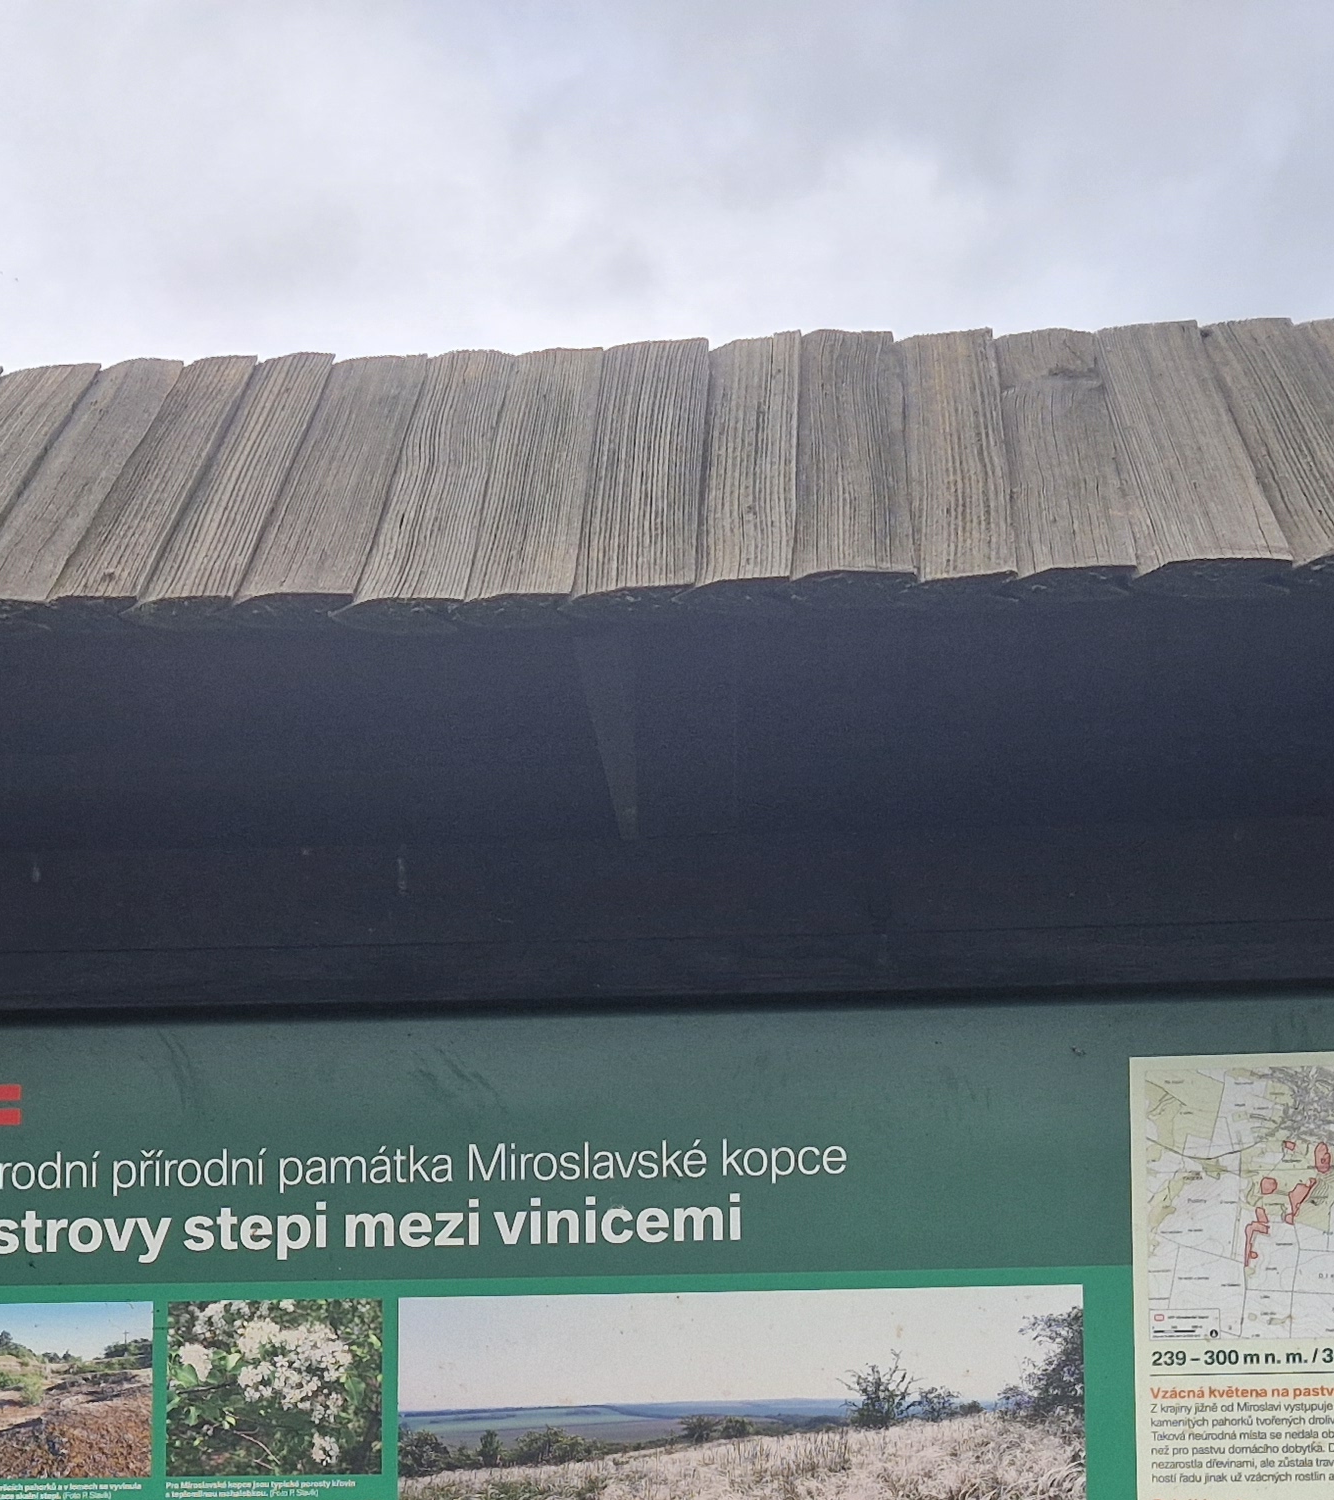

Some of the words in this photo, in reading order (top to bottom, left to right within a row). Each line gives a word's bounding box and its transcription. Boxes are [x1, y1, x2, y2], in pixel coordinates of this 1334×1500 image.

[113, 1148, 266, 1195] přírodní
[279, 1145, 452, 1192] památka
[468, 1140, 706, 1180] Miroslavské
[722, 1139, 846, 1182] kopce
[183, 1202, 326, 1259] stepi
[345, 1199, 479, 1247] mezi
[493, 1194, 740, 1243] vinicemi
[1152, 1350, 1186, 1366] 239
[1204, 1349, 1239, 1365] 300
[1243, 1353, 1259, 1364] m
[1264, 1352, 1281, 1364] n.
[1285, 1352, 1307, 1363] m.
[1150, 1386, 1204, 1399] Vzácná
[1208, 1385, 1267, 1398] květena
[1271, 1387, 1289, 1397] na
[1150, 1403, 1157, 1413] Z
[1160, 1403, 1192, 1415] krajiny
[1194, 1402, 1218, 1415] jižně
[1220, 1402, 1234, 1412] od
[1236, 1401, 1281, 1412] Miroslavi
[1283, 1401, 1333, 1413] vystupuje
[1150, 1416, 1209, 1429] kamenitých
[1211, 1415, 1253, 1428] pahorků
[1255, 1415, 1305, 1427] tvořených
[1151, 1430, 1185, 1441] Taková
[1188, 1430, 1236, 1440] neúrodná
[1239, 1430, 1267, 1439] místa
[1269, 1431, 1282, 1439] se
[1284, 1429, 1318, 1440] nedala
[1150, 1444, 1169, 1455] než
[1172, 1447, 1189, 1456] pro
[1191, 1445, 1225, 1456] pastvu
[1228, 1443, 1279, 1454] domácího
[1151, 1459, 1203, 1469] nezarostla
[1205, 1458, 1257, 1469] dřevinami,
[1259, 1457, 1275, 1468] ale
[1277, 1456, 1313, 1467] zůstala
